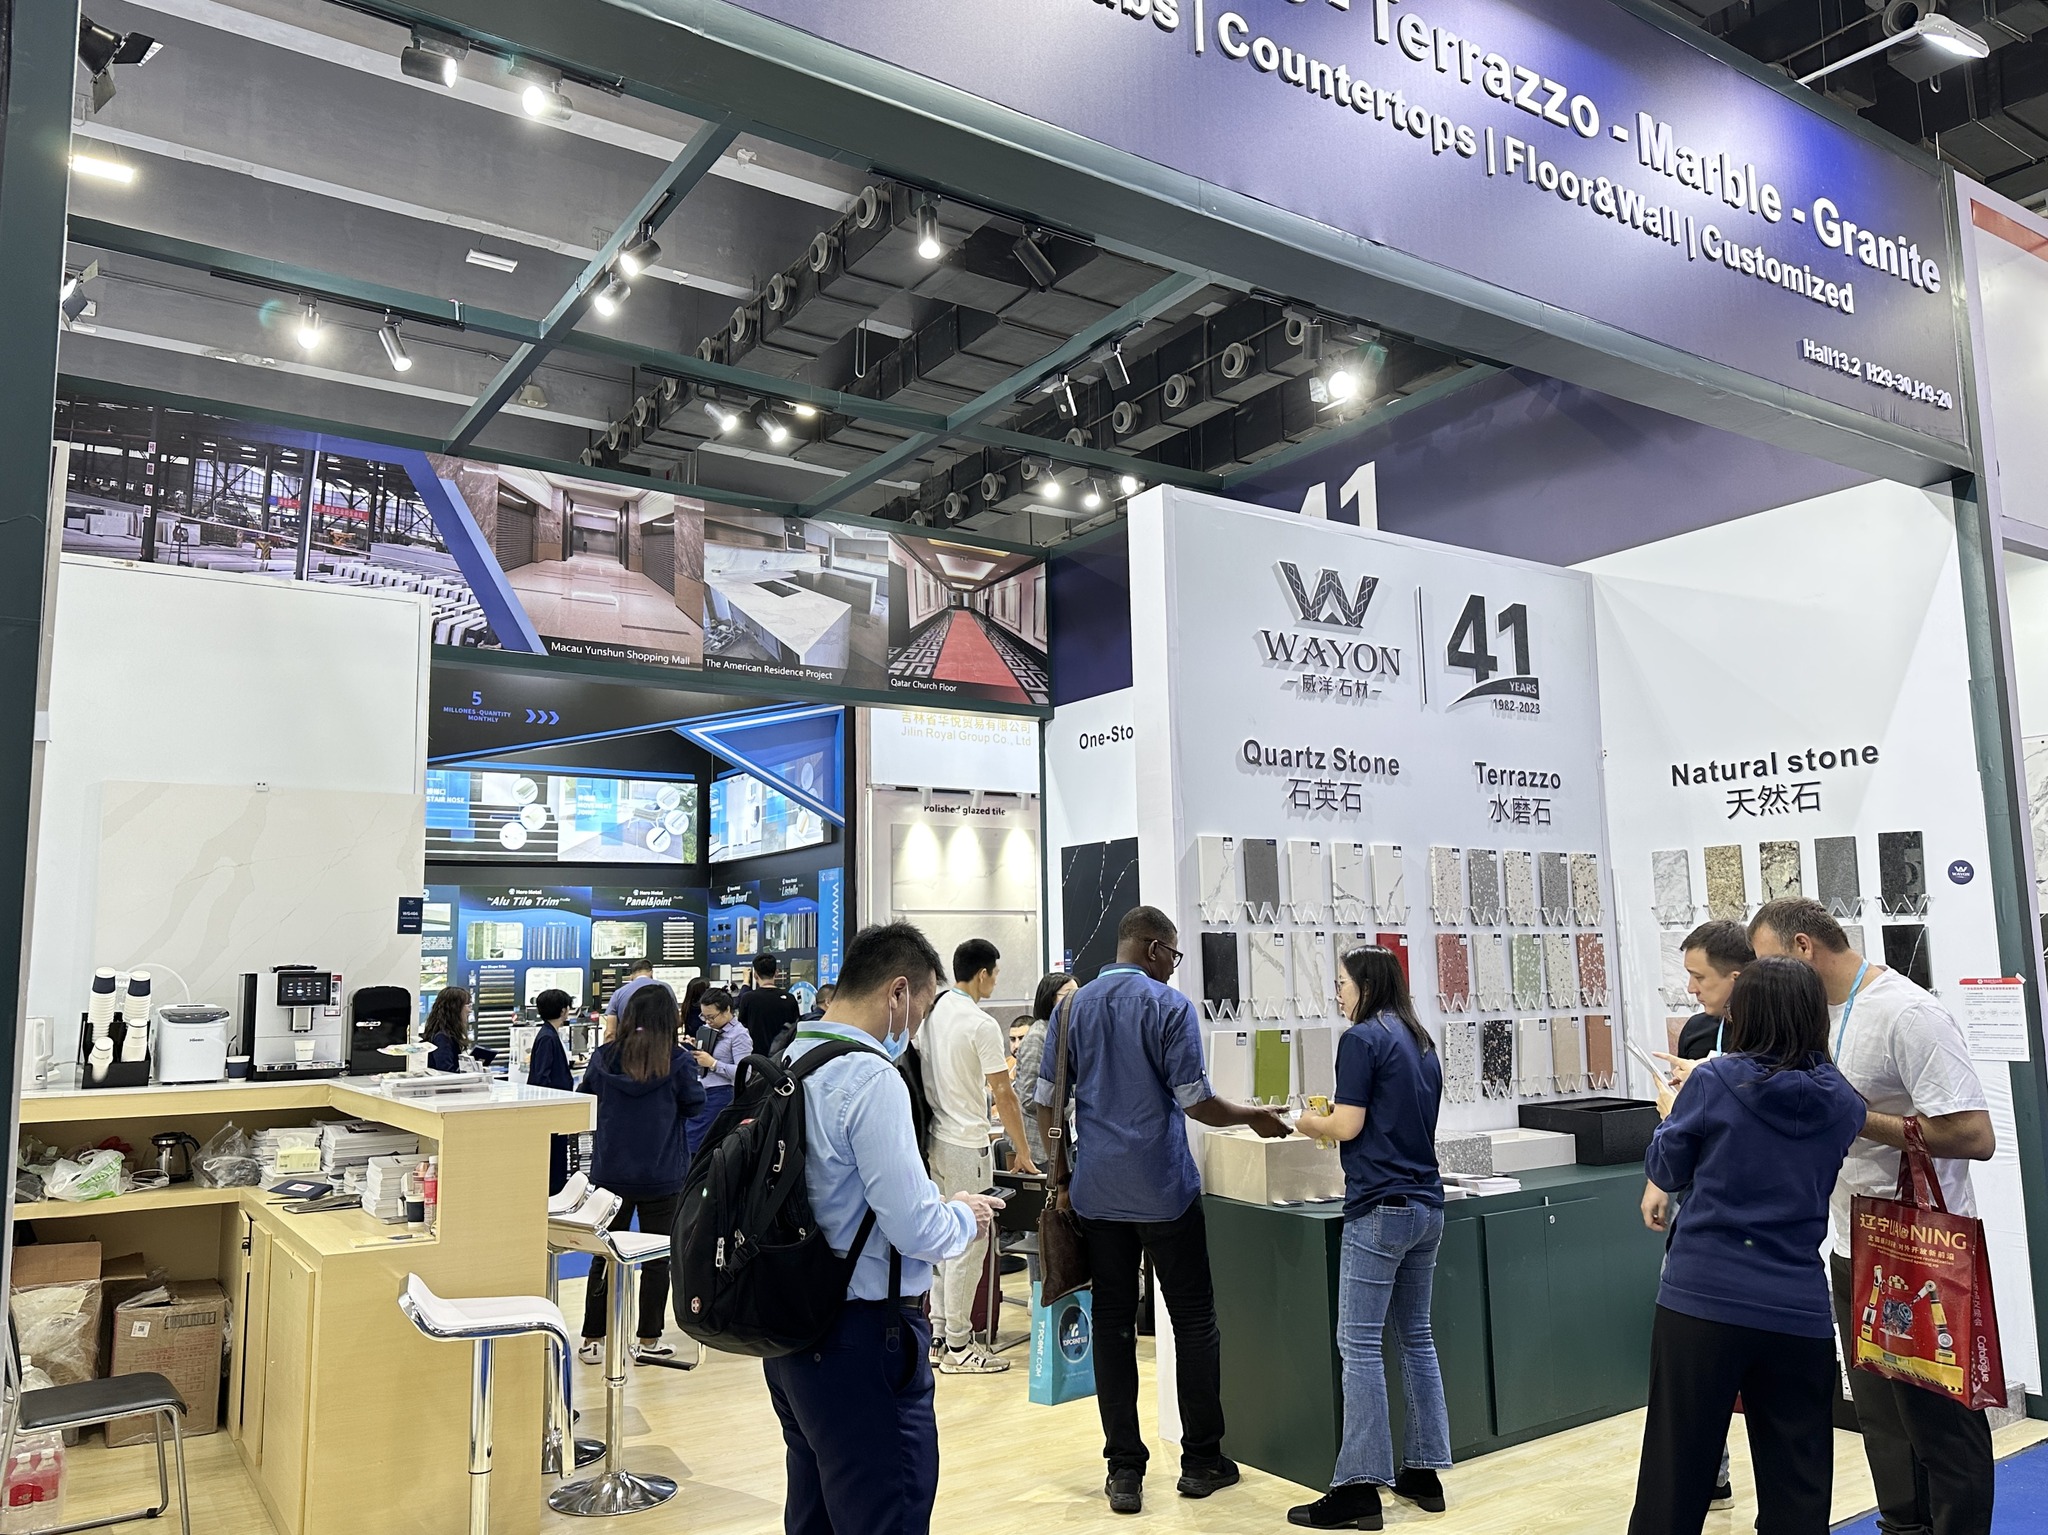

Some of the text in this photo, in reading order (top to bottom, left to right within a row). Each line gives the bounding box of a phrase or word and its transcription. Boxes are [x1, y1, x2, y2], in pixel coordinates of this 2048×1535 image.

[1372, 0, 1600, 138] Terrazzo
[1638, 112, 1782, 222] Marble
[1813, 197, 1941, 293] Granite
[1217, 12, 1477, 157] Countertops
[1504, 135, 1682, 245] Floor&Wall
[1701, 224, 1855, 314] Customized
[1802, 338, 1862, 377] Hall13.2
[1447, 594, 1531, 684] 41
[551, 641, 690, 666] Macau Yunshun Shopping Mall
[1260, 630, 1401, 676] WAYON
[705, 658, 832, 681] The American Residence Project
[471, 691, 482, 705] 5
[890, 678, 957, 692] Qatar Church Floor
[1509, 680, 1537, 694] YEARS
[468, 714, 499, 723] MONTHLY
[1492, 698, 1541, 714] 1982-2023
[901, 725, 923, 738] Jilin
[925, 727, 956, 742] Royal
[958, 730, 990, 745] Group
[1016, 735, 1032, 746] Ltd
[1079, 725, 1134, 750] One-Sto
[1243, 740, 1401, 776] Quartz Stone
[1670, 745, 1880, 787] Natural stone
[1474, 762, 1562, 790] Terrazzo
[1287, 778, 1362, 813] 石英石
[1726, 780, 1822, 820] 天然石
[962, 806, 990, 816] glazed
[1489, 796, 1552, 825] 水磨石
[490, 896, 510, 906] Alu
[512, 896, 532, 906] Tile
[535, 896, 559, 906] Trim
[1860, 1213, 1889, 1233] 辽宁
[1976, 1335, 1990, 1383] Catalogue
